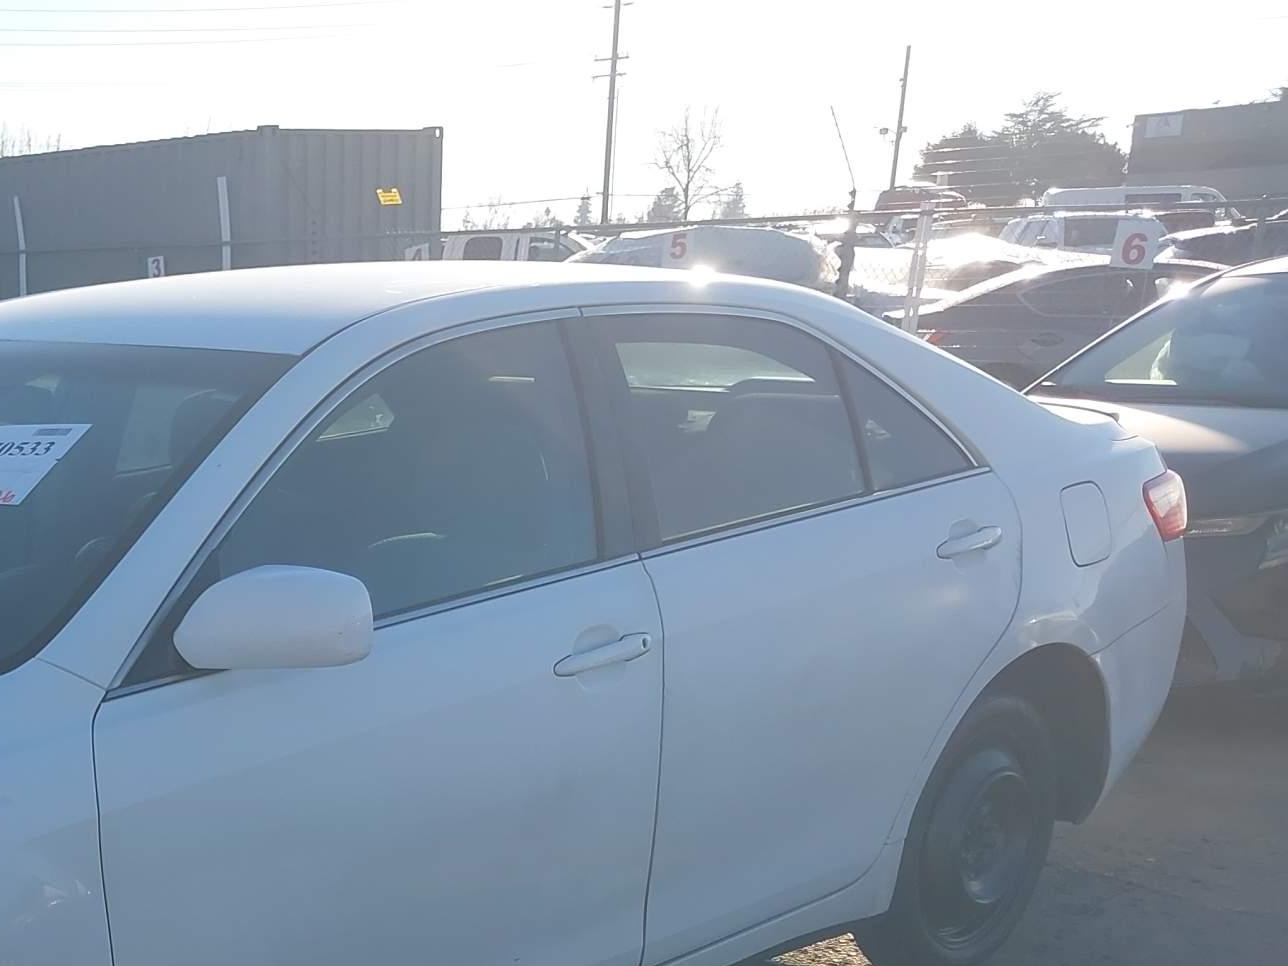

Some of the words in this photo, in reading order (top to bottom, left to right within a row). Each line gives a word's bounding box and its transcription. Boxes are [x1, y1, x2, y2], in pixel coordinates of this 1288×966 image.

[670, 232, 688, 260] 5
[1121, 232, 1148, 265] 6
[151, 257, 162, 279] 3
